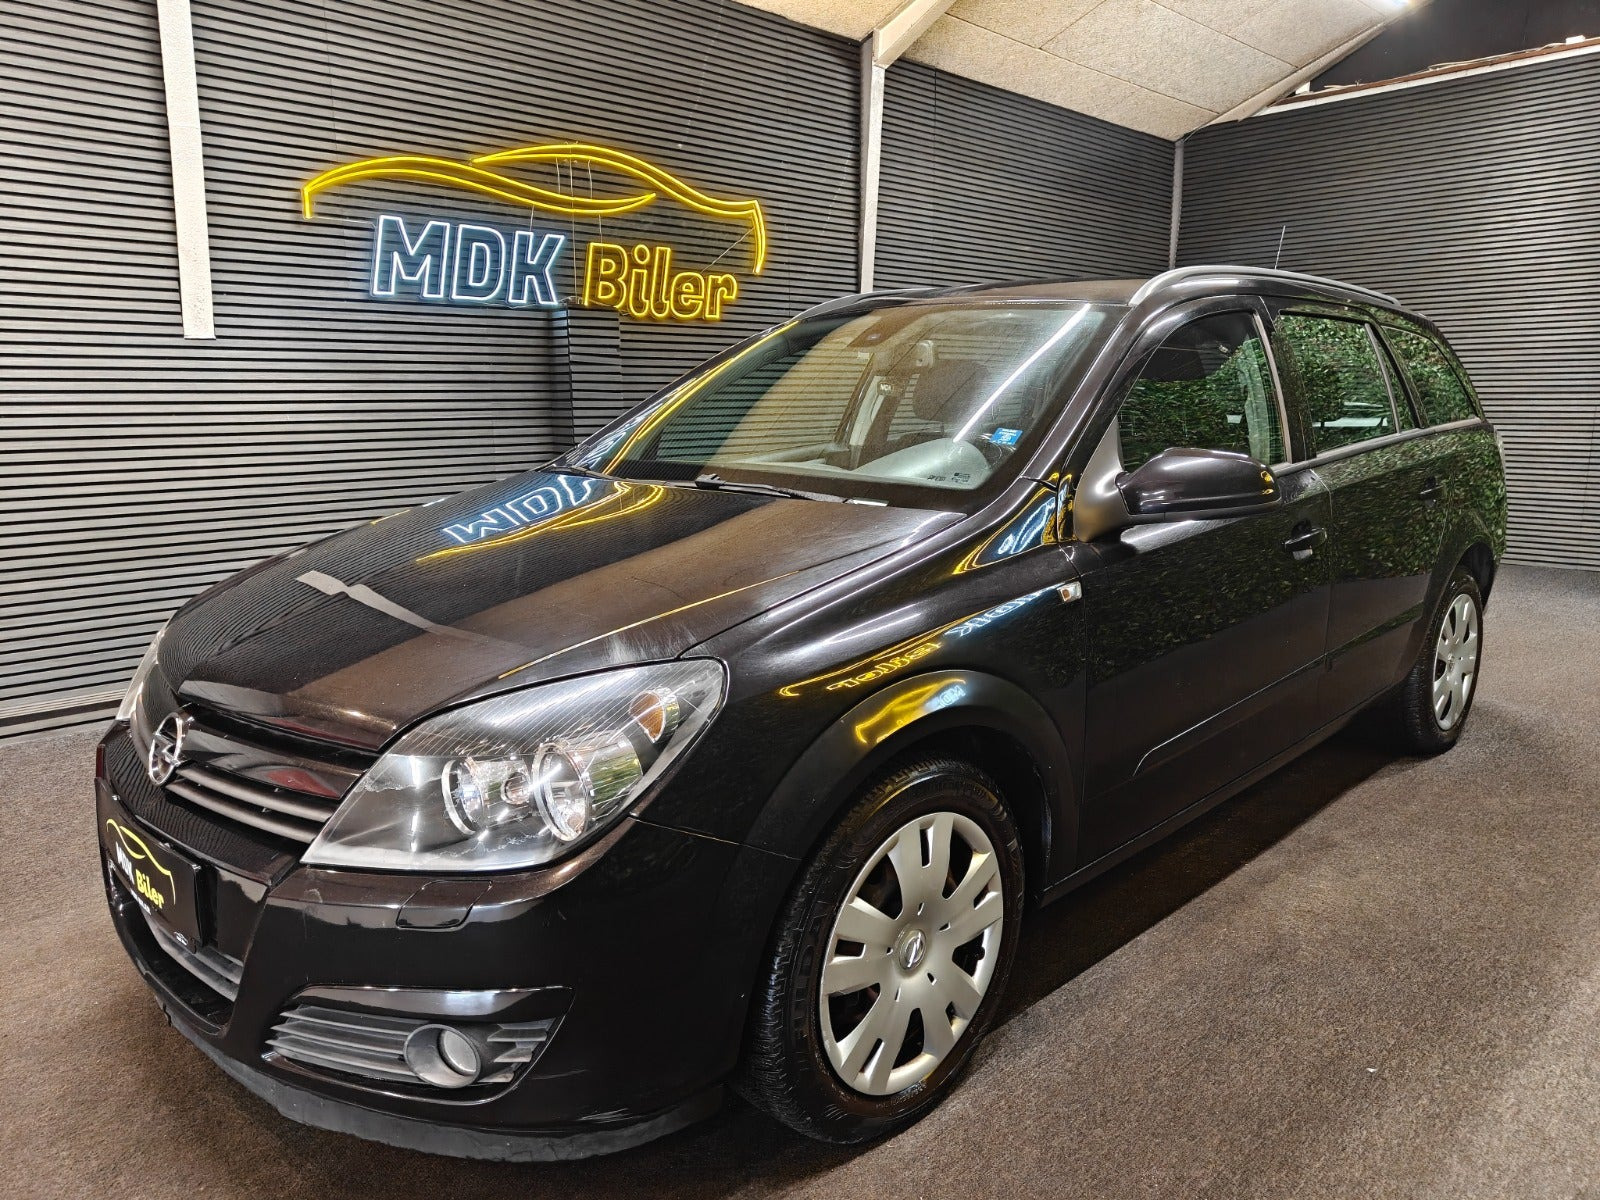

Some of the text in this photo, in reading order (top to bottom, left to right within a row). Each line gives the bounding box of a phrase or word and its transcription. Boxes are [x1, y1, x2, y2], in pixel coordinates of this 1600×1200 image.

[371, 214, 738, 320] MDK Biler
[135, 868, 165, 909] Biler
